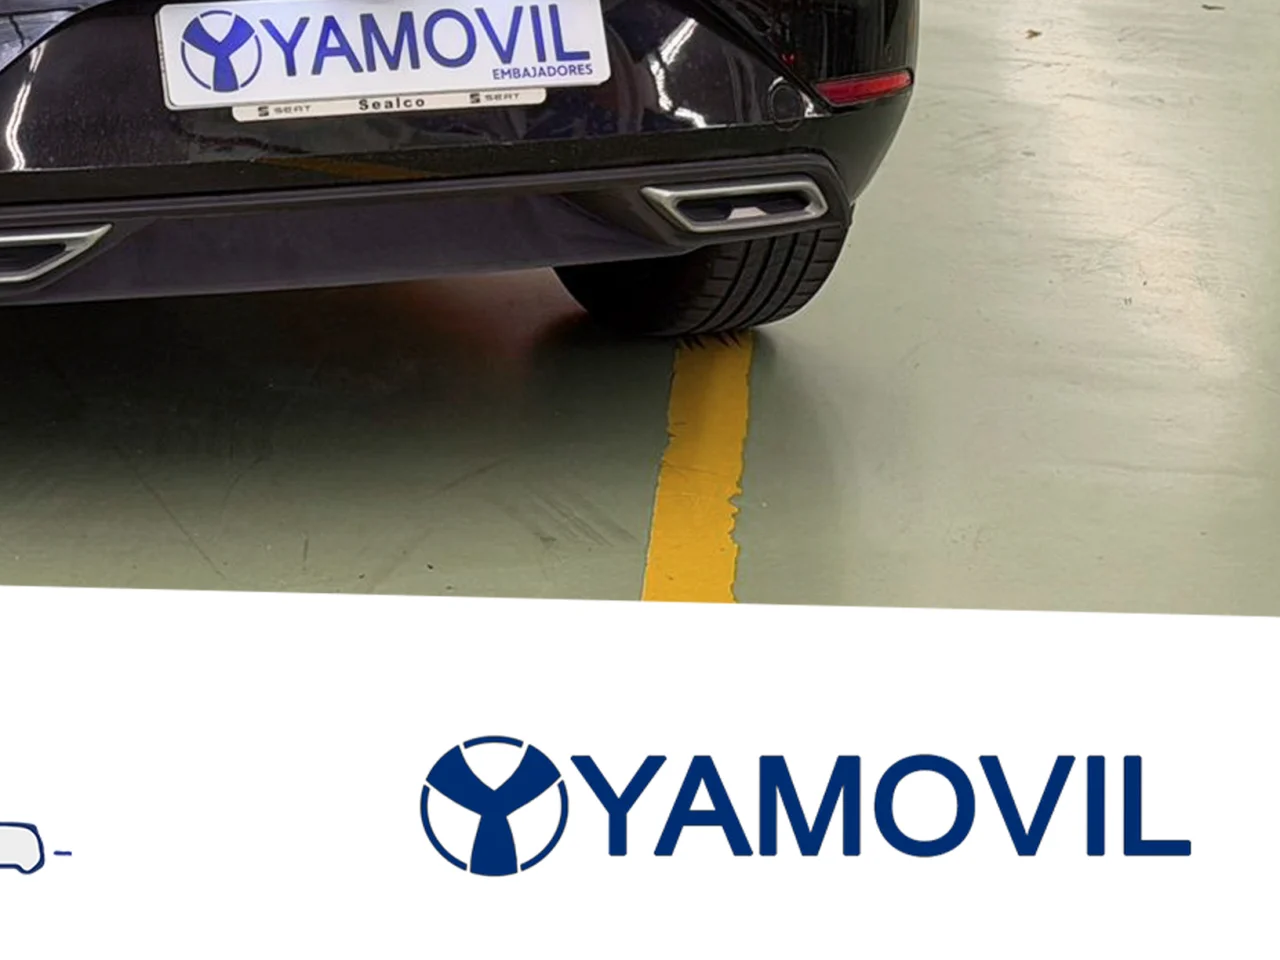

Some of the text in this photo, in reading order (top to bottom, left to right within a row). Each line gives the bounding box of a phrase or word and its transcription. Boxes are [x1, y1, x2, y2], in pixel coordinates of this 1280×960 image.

[260, 4, 590, 77] YAMOVIL
[492, 63, 594, 81] EMBAJADORES
[358, 97, 426, 111] Sealco
